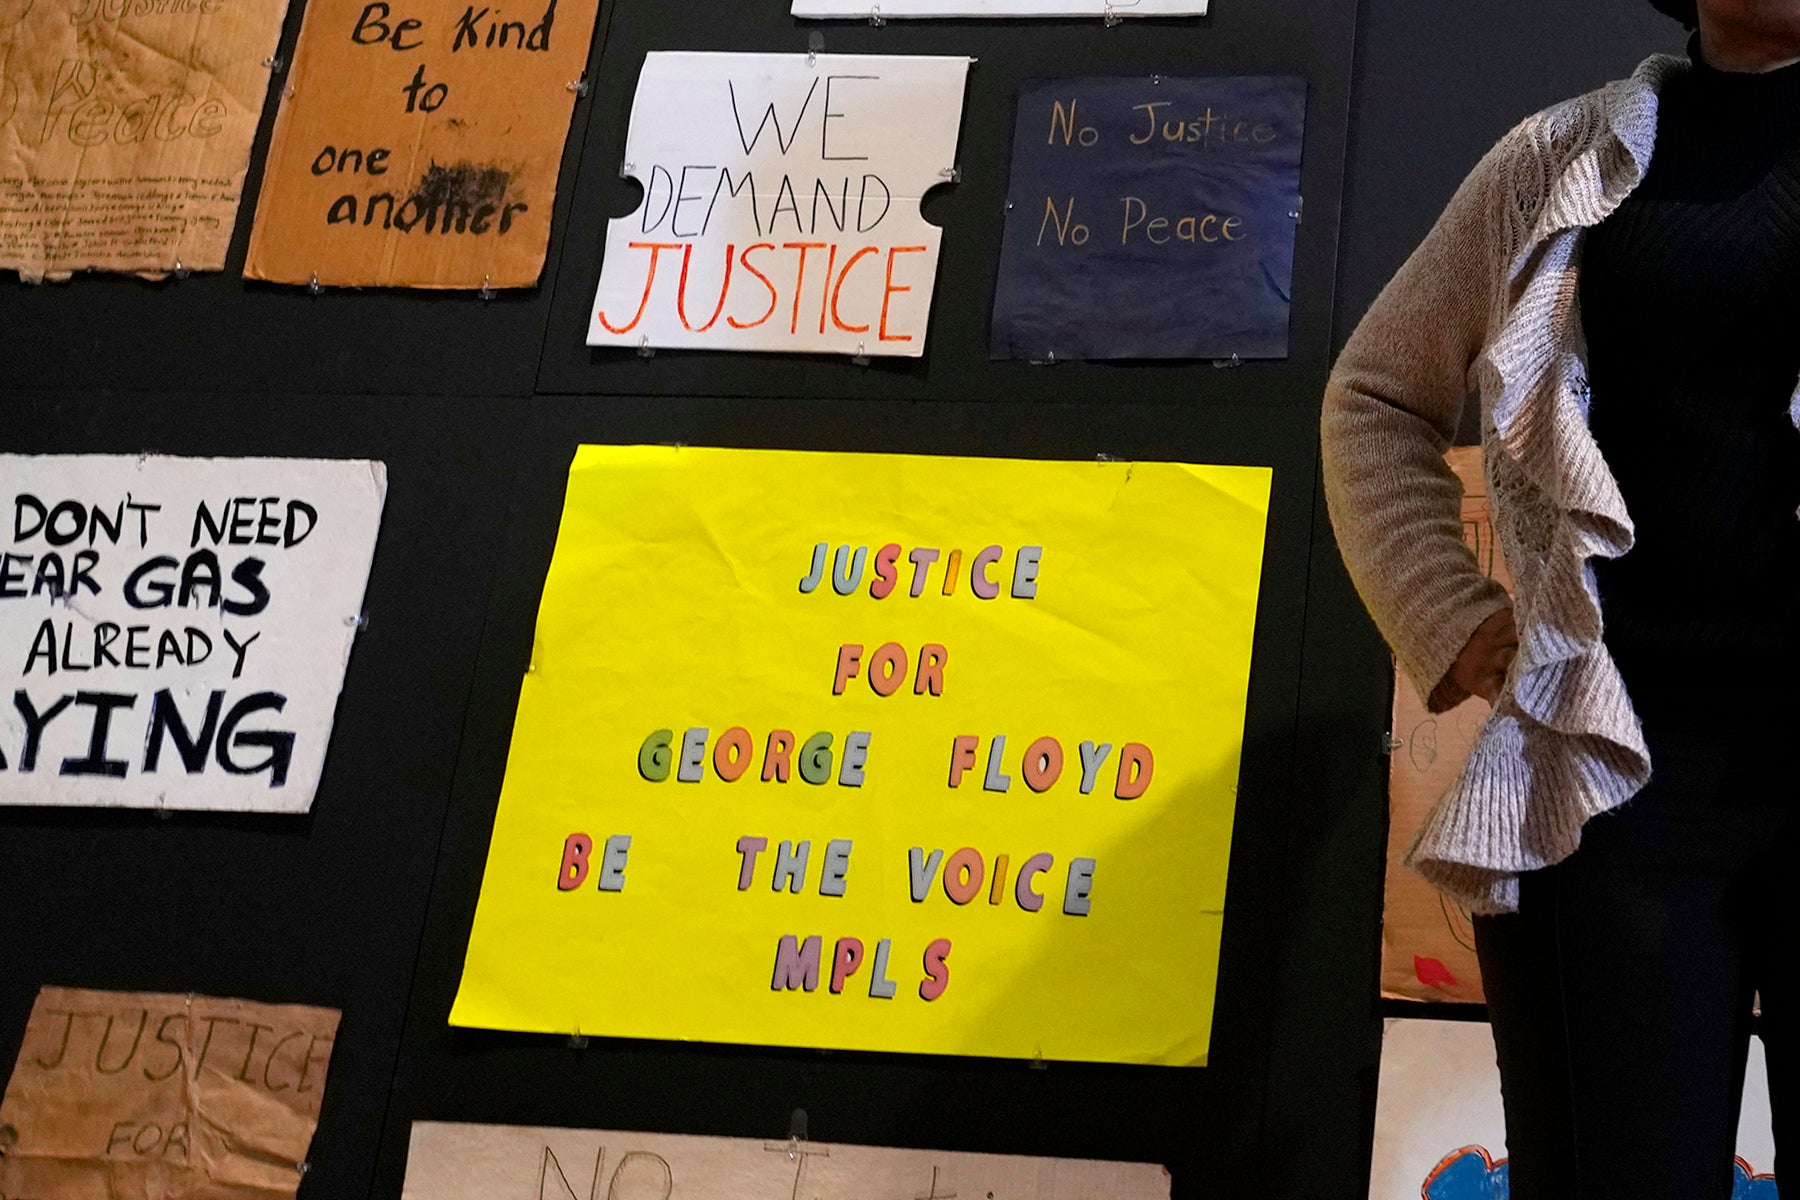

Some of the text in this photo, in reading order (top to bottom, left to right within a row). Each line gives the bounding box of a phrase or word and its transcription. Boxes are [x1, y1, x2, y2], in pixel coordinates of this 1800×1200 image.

[351, 2, 425, 52] Be
[40, 57, 228, 148] Peace
[402, 64, 449, 114] to
[728, 75, 881, 161] WE
[1047, 100, 1277, 148] No Justice
[310, 145, 391, 176] one
[640, 164, 890, 238] DEMAND
[1036, 196, 1245, 248] No Peace
[598, 241, 927, 342] JUSTICE
[14, 492, 319, 550] DON'T NEED
[123, 548, 271, 616] GAS
[798, 542, 1044, 601] JUSTICE
[23, 618, 260, 678] ALREADY
[831, 642, 950, 696] FOR
[638, 726, 1156, 800] GEORGE FLOYD
[556, 832, 1097, 918] BE THE VOICE
